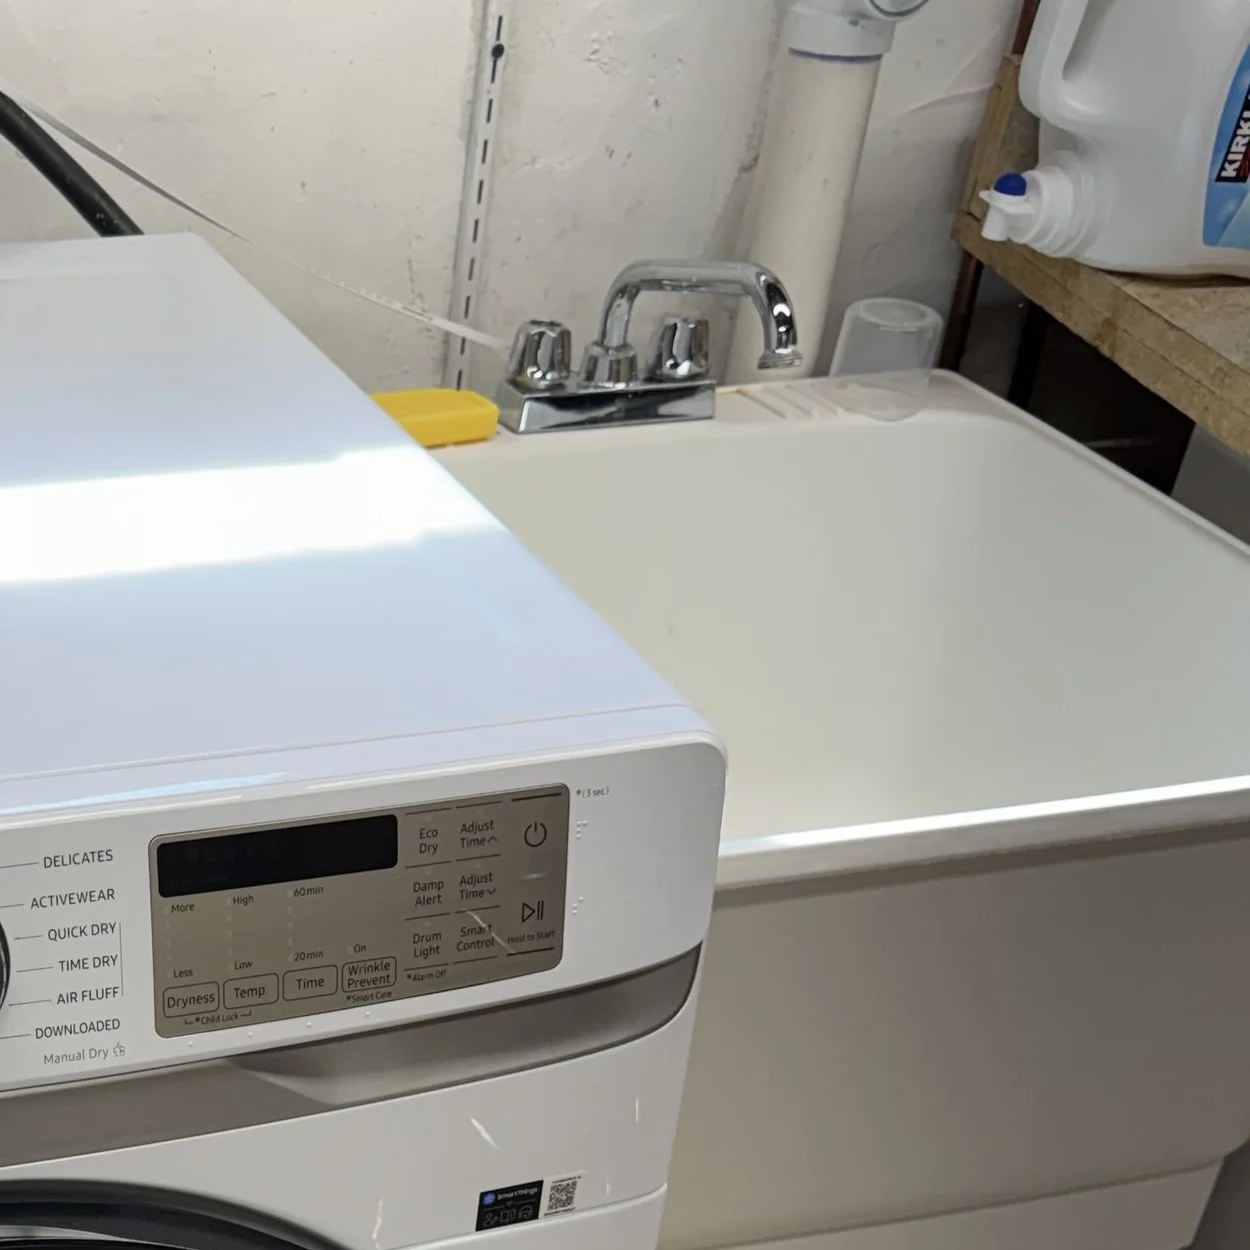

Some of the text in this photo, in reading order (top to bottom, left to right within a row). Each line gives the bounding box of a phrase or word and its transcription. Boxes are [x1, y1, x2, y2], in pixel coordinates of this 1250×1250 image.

[1220, 94, 1250, 178] KIRK
[420, 828, 438, 839] Eco
[460, 820, 494, 835] Adjust
[420, 842, 438, 854] Dry
[461, 836, 486, 848] Time
[43, 849, 113, 869] DELICATES
[413, 879, 444, 894] Damp
[459, 872, 494, 888] Adjust
[30, 889, 115, 909] ACTIVEWEAR
[233, 894, 254, 906] High
[414, 894, 442, 906] Alert
[460, 888, 485, 900] Time
[171, 903, 195, 913] More
[48, 922, 117, 943] QUICK DRY
[412, 931, 442, 944] Drum
[460, 924, 492, 938] Smart
[354, 944, 366, 953] On
[456, 936, 495, 952] Control
[414, 946, 440, 958] Light
[58, 954, 118, 972] TIME DRY
[234, 960, 252, 970] Low
[348, 960, 391, 976] Wrinkle
[174, 968, 194, 978] Less
[296, 977, 325, 990] Time
[348, 974, 390, 988] Prevent
[56, 986, 120, 1006] AIR FLUFF
[167, 992, 216, 1010] Dryness
[376, 991, 393, 1000] Care
[222, 1012, 239, 1022] Lock
[35, 1018, 121, 1040] DOWNLOADED
[43, 1046, 109, 1066] Manual Dry
